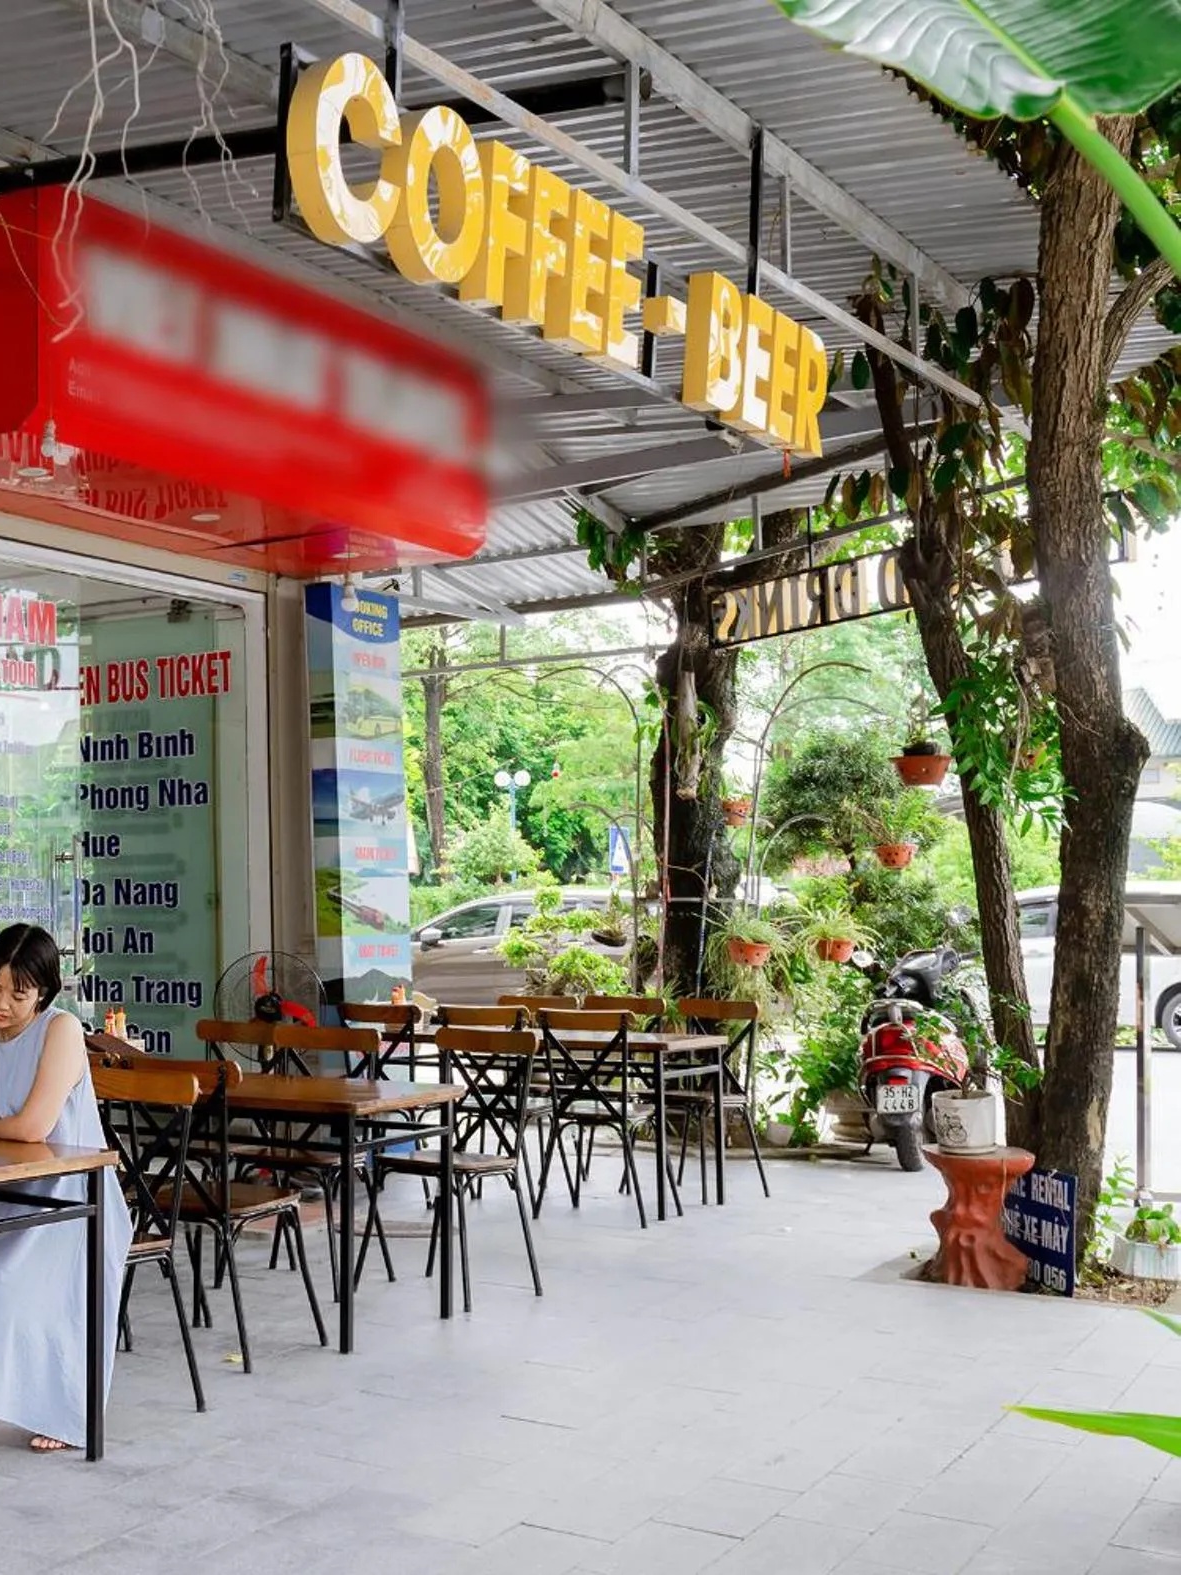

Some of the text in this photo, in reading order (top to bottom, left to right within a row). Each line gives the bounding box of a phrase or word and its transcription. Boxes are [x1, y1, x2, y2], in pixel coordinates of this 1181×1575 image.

[286, 51, 645, 368] COFFEE
[682, 271, 828, 458] BEER
[1, 658, 36, 687] TOUR
[106, 658, 150, 704] BUS
[156, 650, 232, 699] TICKET
[76, 777, 210, 812] Phong Nha
[114, 878, 180, 909] Nang
[122, 926, 155, 955] An
[77, 973, 204, 1009] Nha Trang
[1030, 1172, 1071, 1211] RENTAL
[1023, 1214, 1039, 1245] XE
[1041, 1216, 1070, 1255] MÁY
